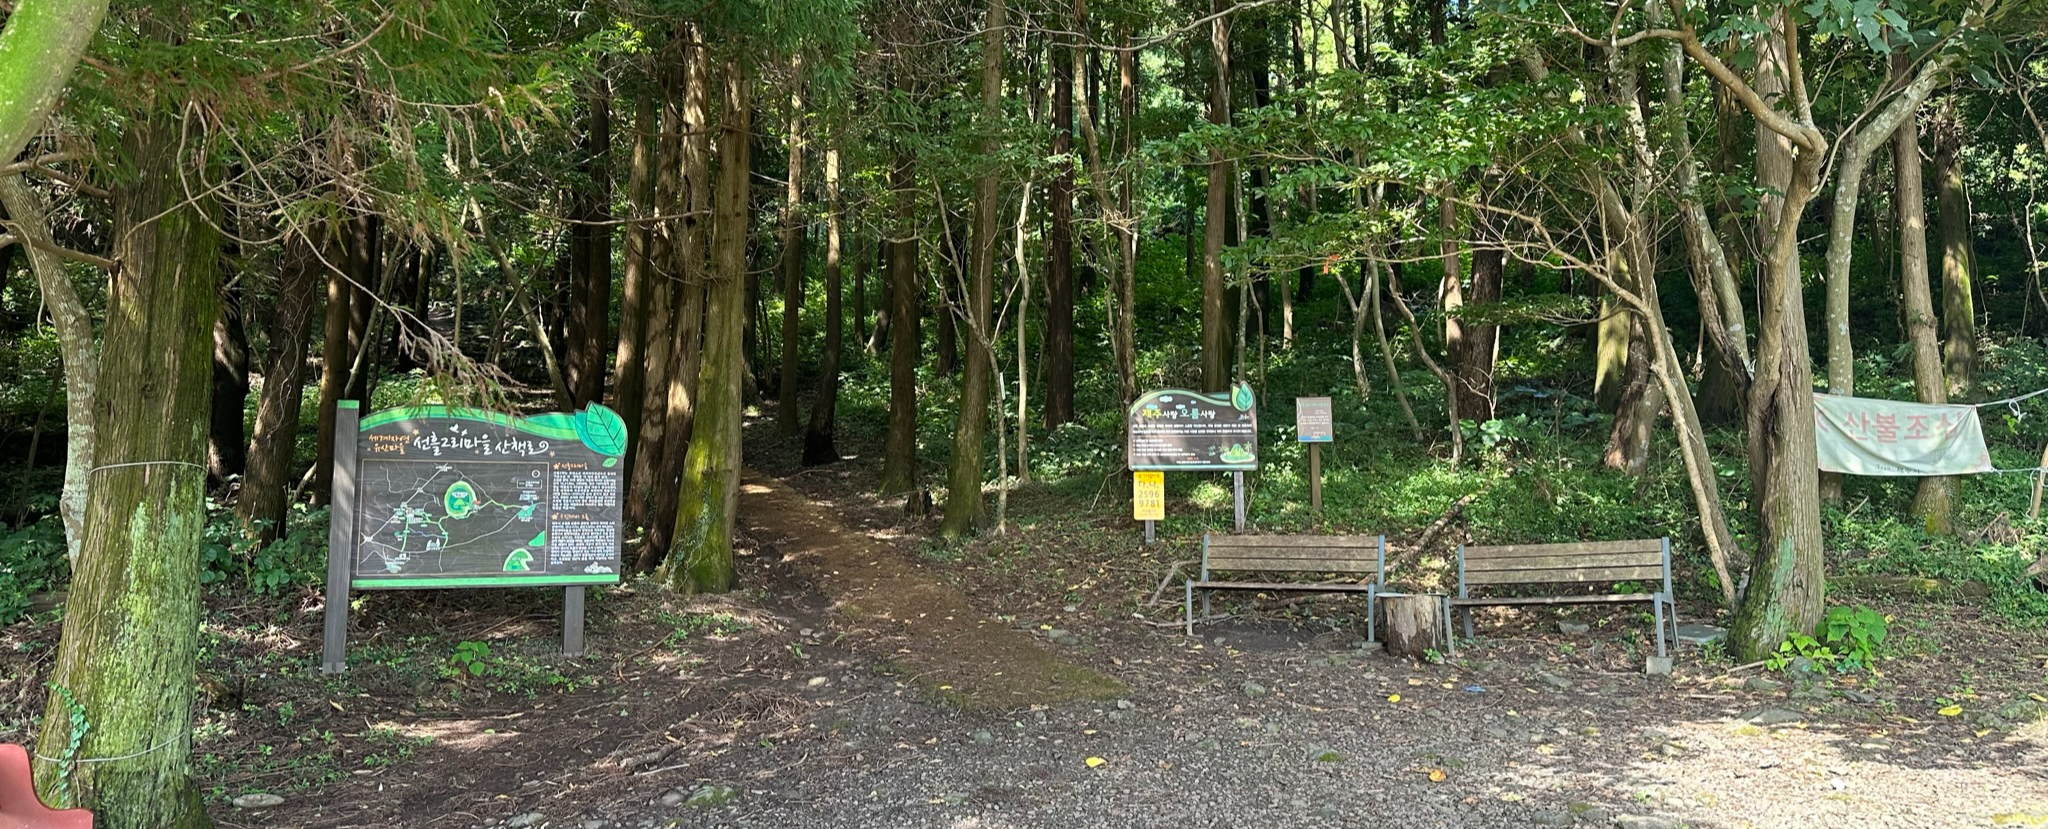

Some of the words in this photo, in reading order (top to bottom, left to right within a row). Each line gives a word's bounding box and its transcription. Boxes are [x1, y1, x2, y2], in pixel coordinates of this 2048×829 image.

[1142, 409, 1178, 420] 제주사랑
[1180, 408, 1216, 420] 오름사랑
[413, 431, 493, 456] 선흘2리마을
[495, 439, 549, 457] 산책로
[1138, 490, 1160, 499] 2596
[1138, 499, 1160, 508] 9781
